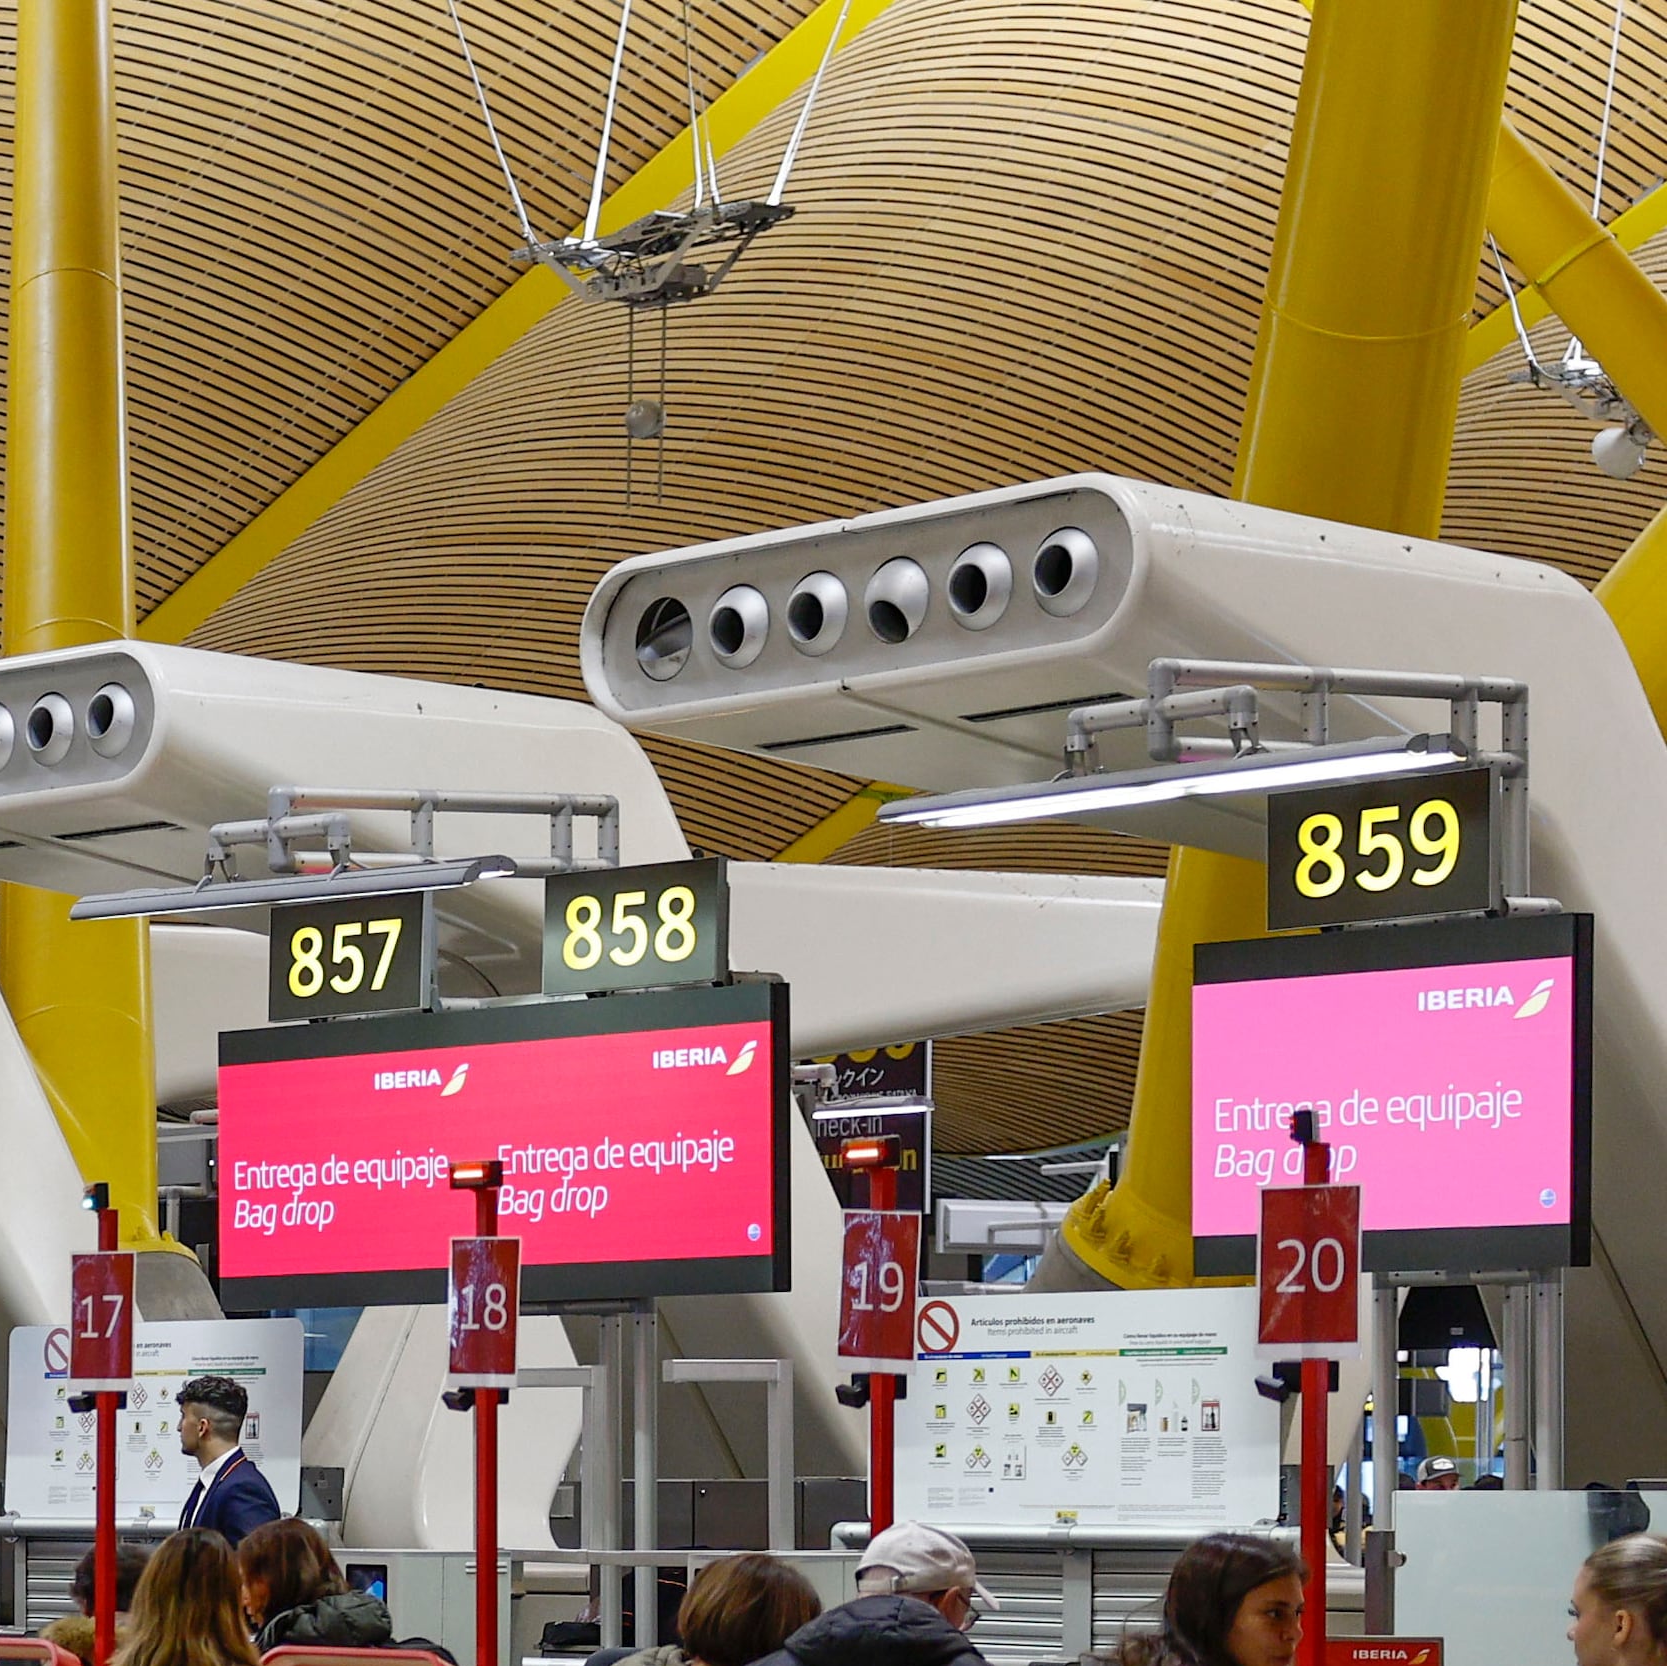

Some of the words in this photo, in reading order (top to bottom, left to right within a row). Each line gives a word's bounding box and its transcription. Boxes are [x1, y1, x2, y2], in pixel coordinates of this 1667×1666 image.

[1294, 798, 1461, 899] 859
[562, 885, 698, 971] 858
[288, 918, 403, 998] 857
[1417, 985, 1514, 1012] IBERIA
[373, 1068, 442, 1091] IBERIA
[652, 1046, 728, 1069] IBERIA
[816, 1115, 883, 1138] heck-in
[1214, 1097, 1333, 1133] Entrea
[1339, 1088, 1380, 1127] de
[1385, 1081, 1524, 1132] equipaje
[234, 1158, 317, 1198] Entrega
[321, 1153, 349, 1186] de
[354, 1148, 449, 1190] equipaje
[497, 1143, 590, 1179] Entrega
[594, 1136, 625, 1169] de
[629, 1129, 735, 1175] equipaje
[1214, 1143, 1276, 1186] Bag
[1283, 1143, 1358, 1183] dp
[234, 1199, 278, 1235] Bag
[282, 1193, 335, 1231] drop
[497, 1184, 545, 1222] Bag
[551, 1178, 608, 1218] drop
[850, 1260, 904, 1313] 19
[1275, 1236, 1345, 1294] 20
[80, 1294, 124, 1339] 17
[460, 1282, 508, 1331] 18
[1352, 1649, 1408, 1661] IBERIA
